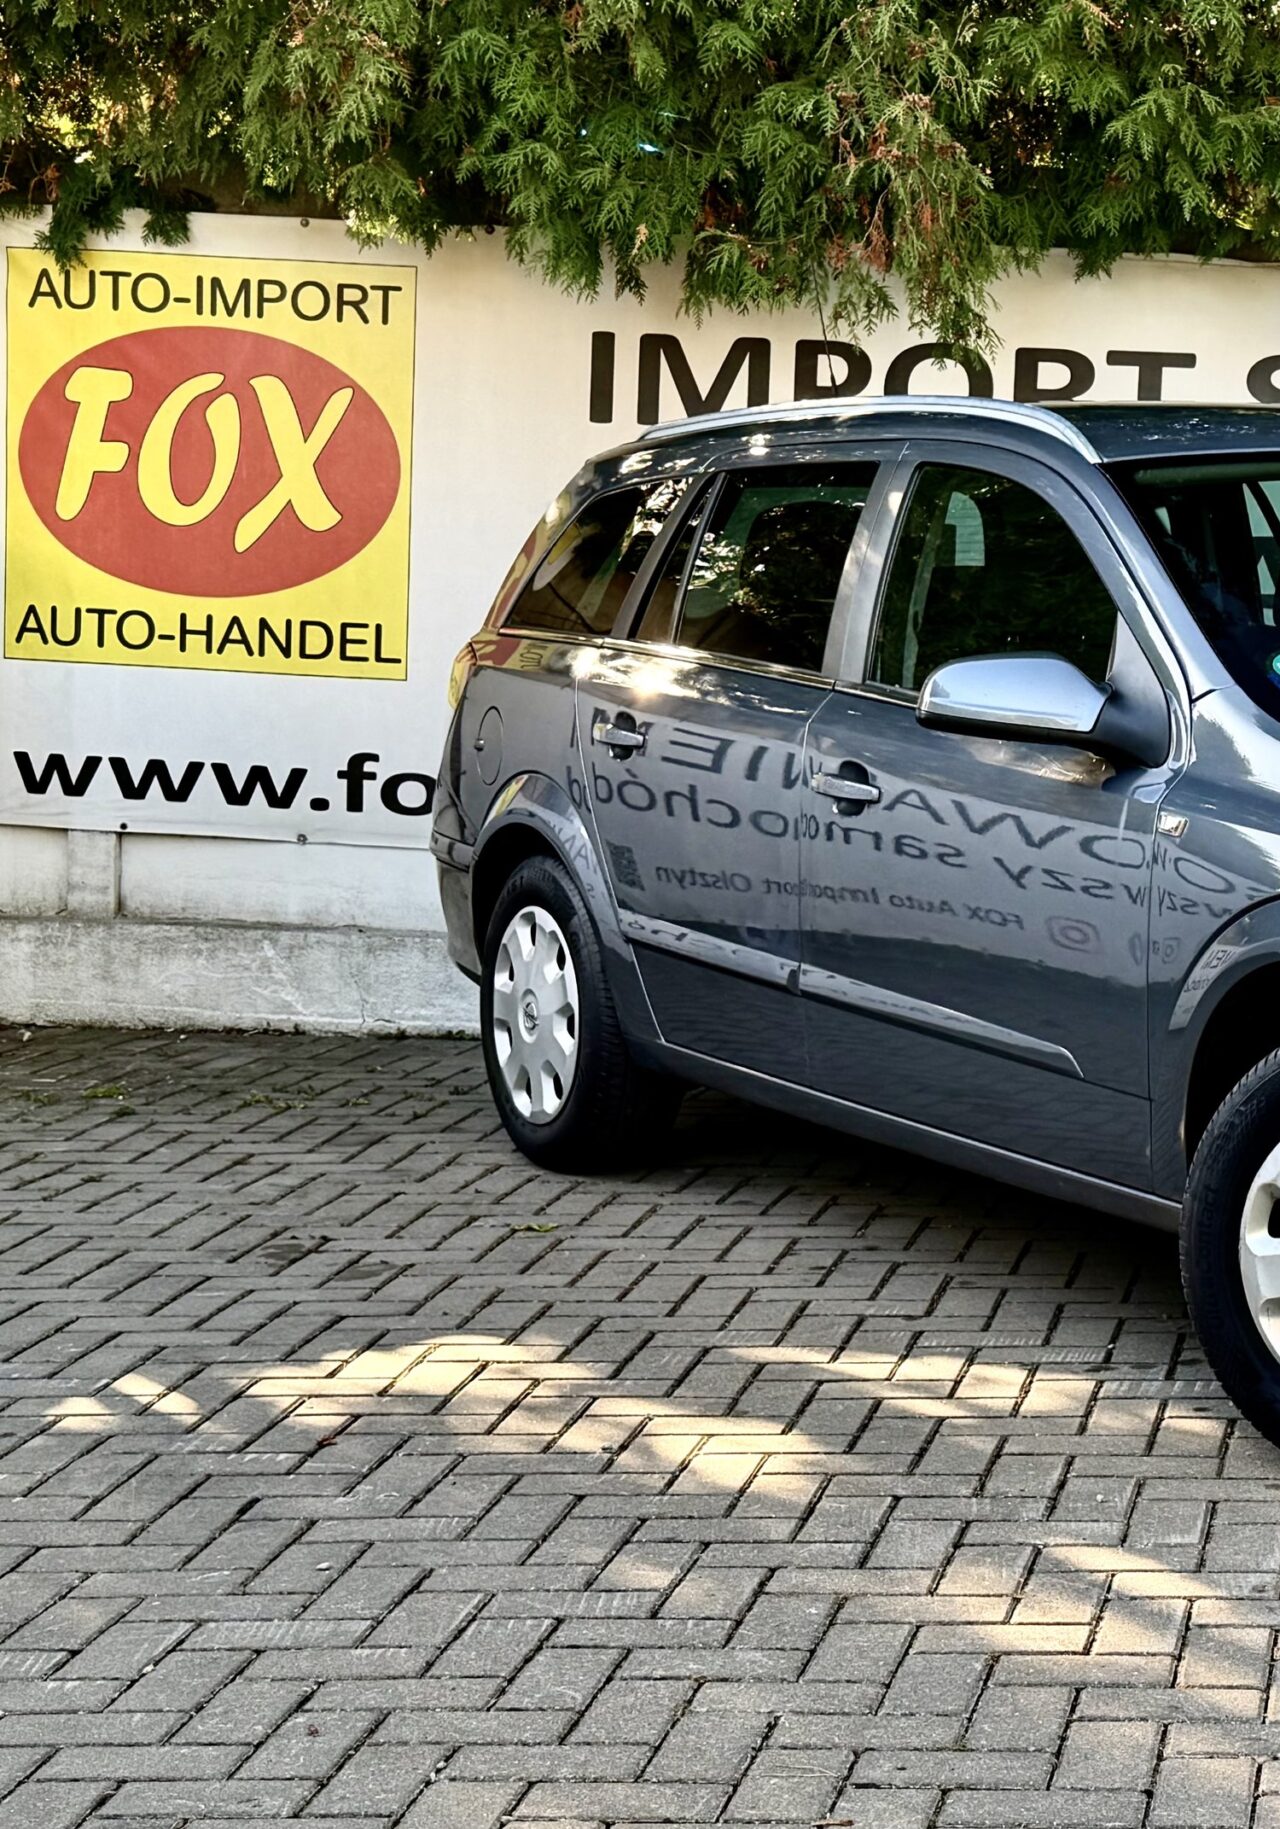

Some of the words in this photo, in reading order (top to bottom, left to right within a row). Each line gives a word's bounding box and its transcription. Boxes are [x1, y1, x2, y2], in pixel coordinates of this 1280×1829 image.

[28, 268, 402, 325] AUTO-IMPORT
[590, 331, 1197, 425] IMPORT
[55, 366, 355, 554] FOX
[15, 604, 402, 664] AUTO-HANDEL
